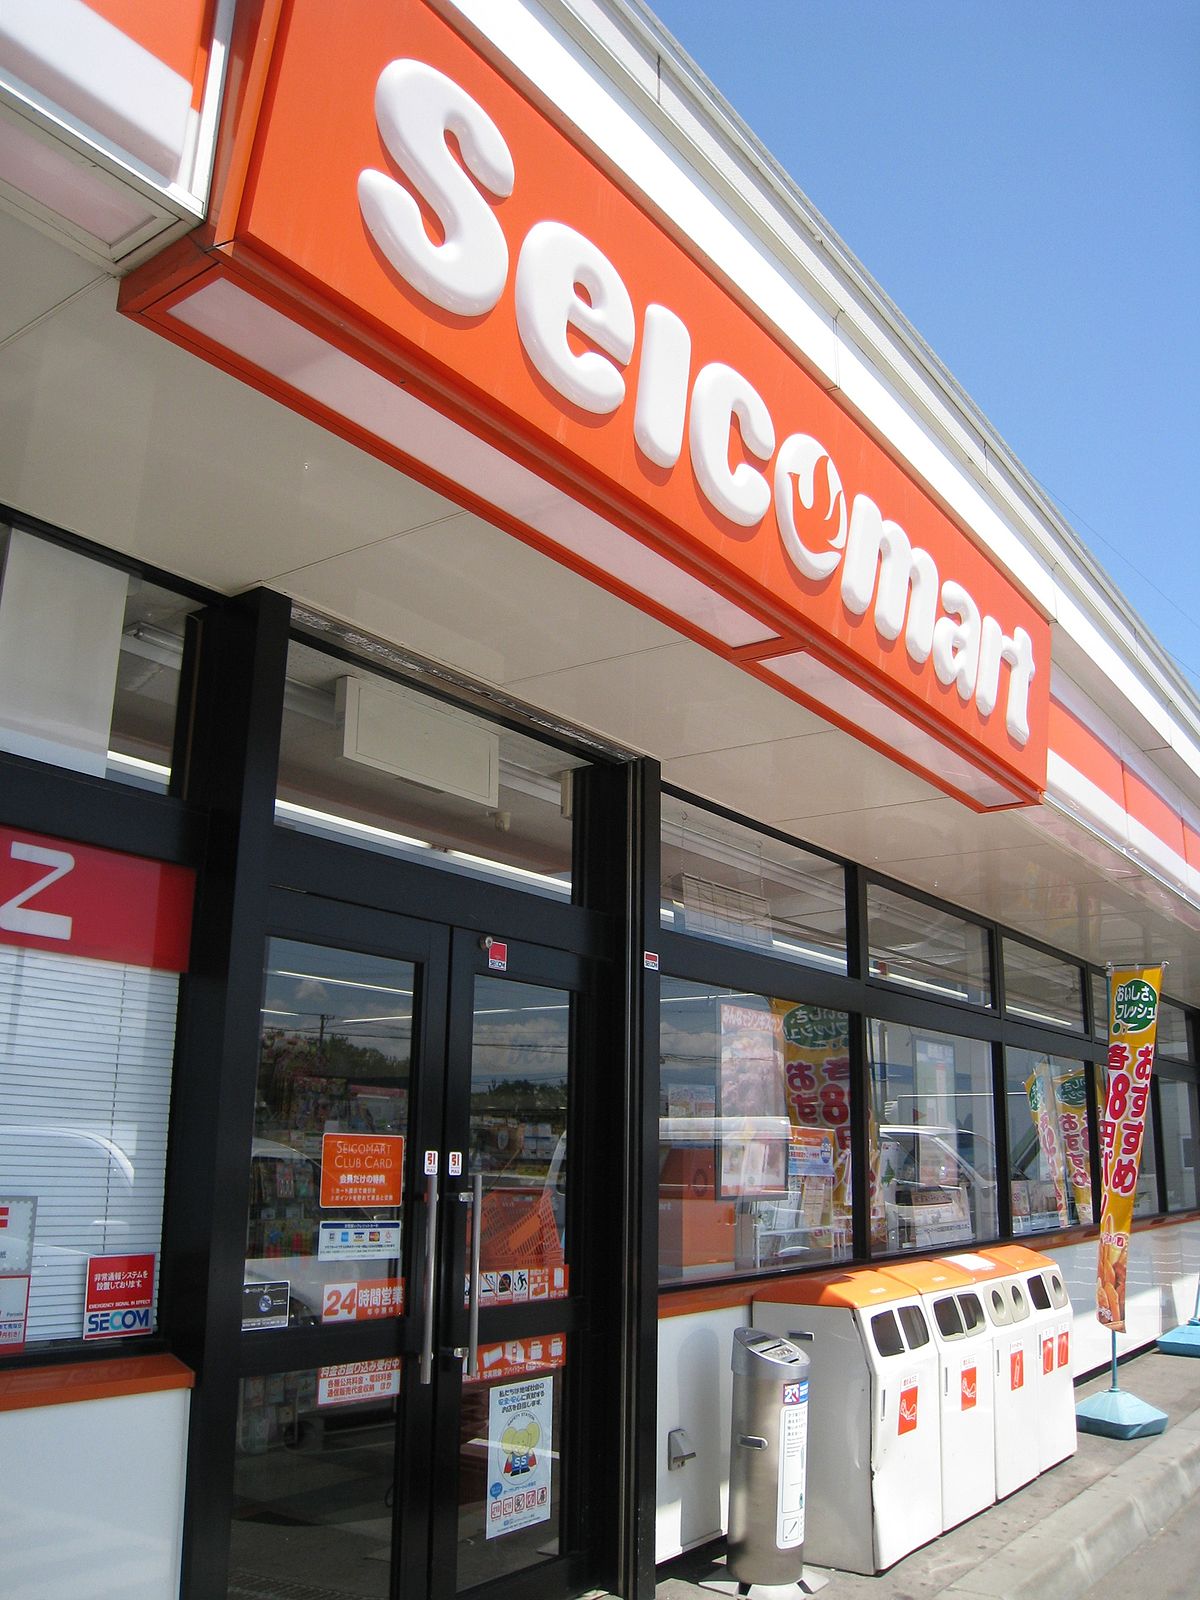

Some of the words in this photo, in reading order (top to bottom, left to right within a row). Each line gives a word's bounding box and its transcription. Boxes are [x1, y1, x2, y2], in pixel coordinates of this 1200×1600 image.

[357, 57, 1036, 746] Seicomart
[1112, 1045, 1154, 1194] おすすめ
[334, 1155, 361, 1168] CLUB
[364, 1156, 393, 1169] CARD
[323, 1288, 357, 1317] 24
[88, 1309, 150, 1333] SECOM
